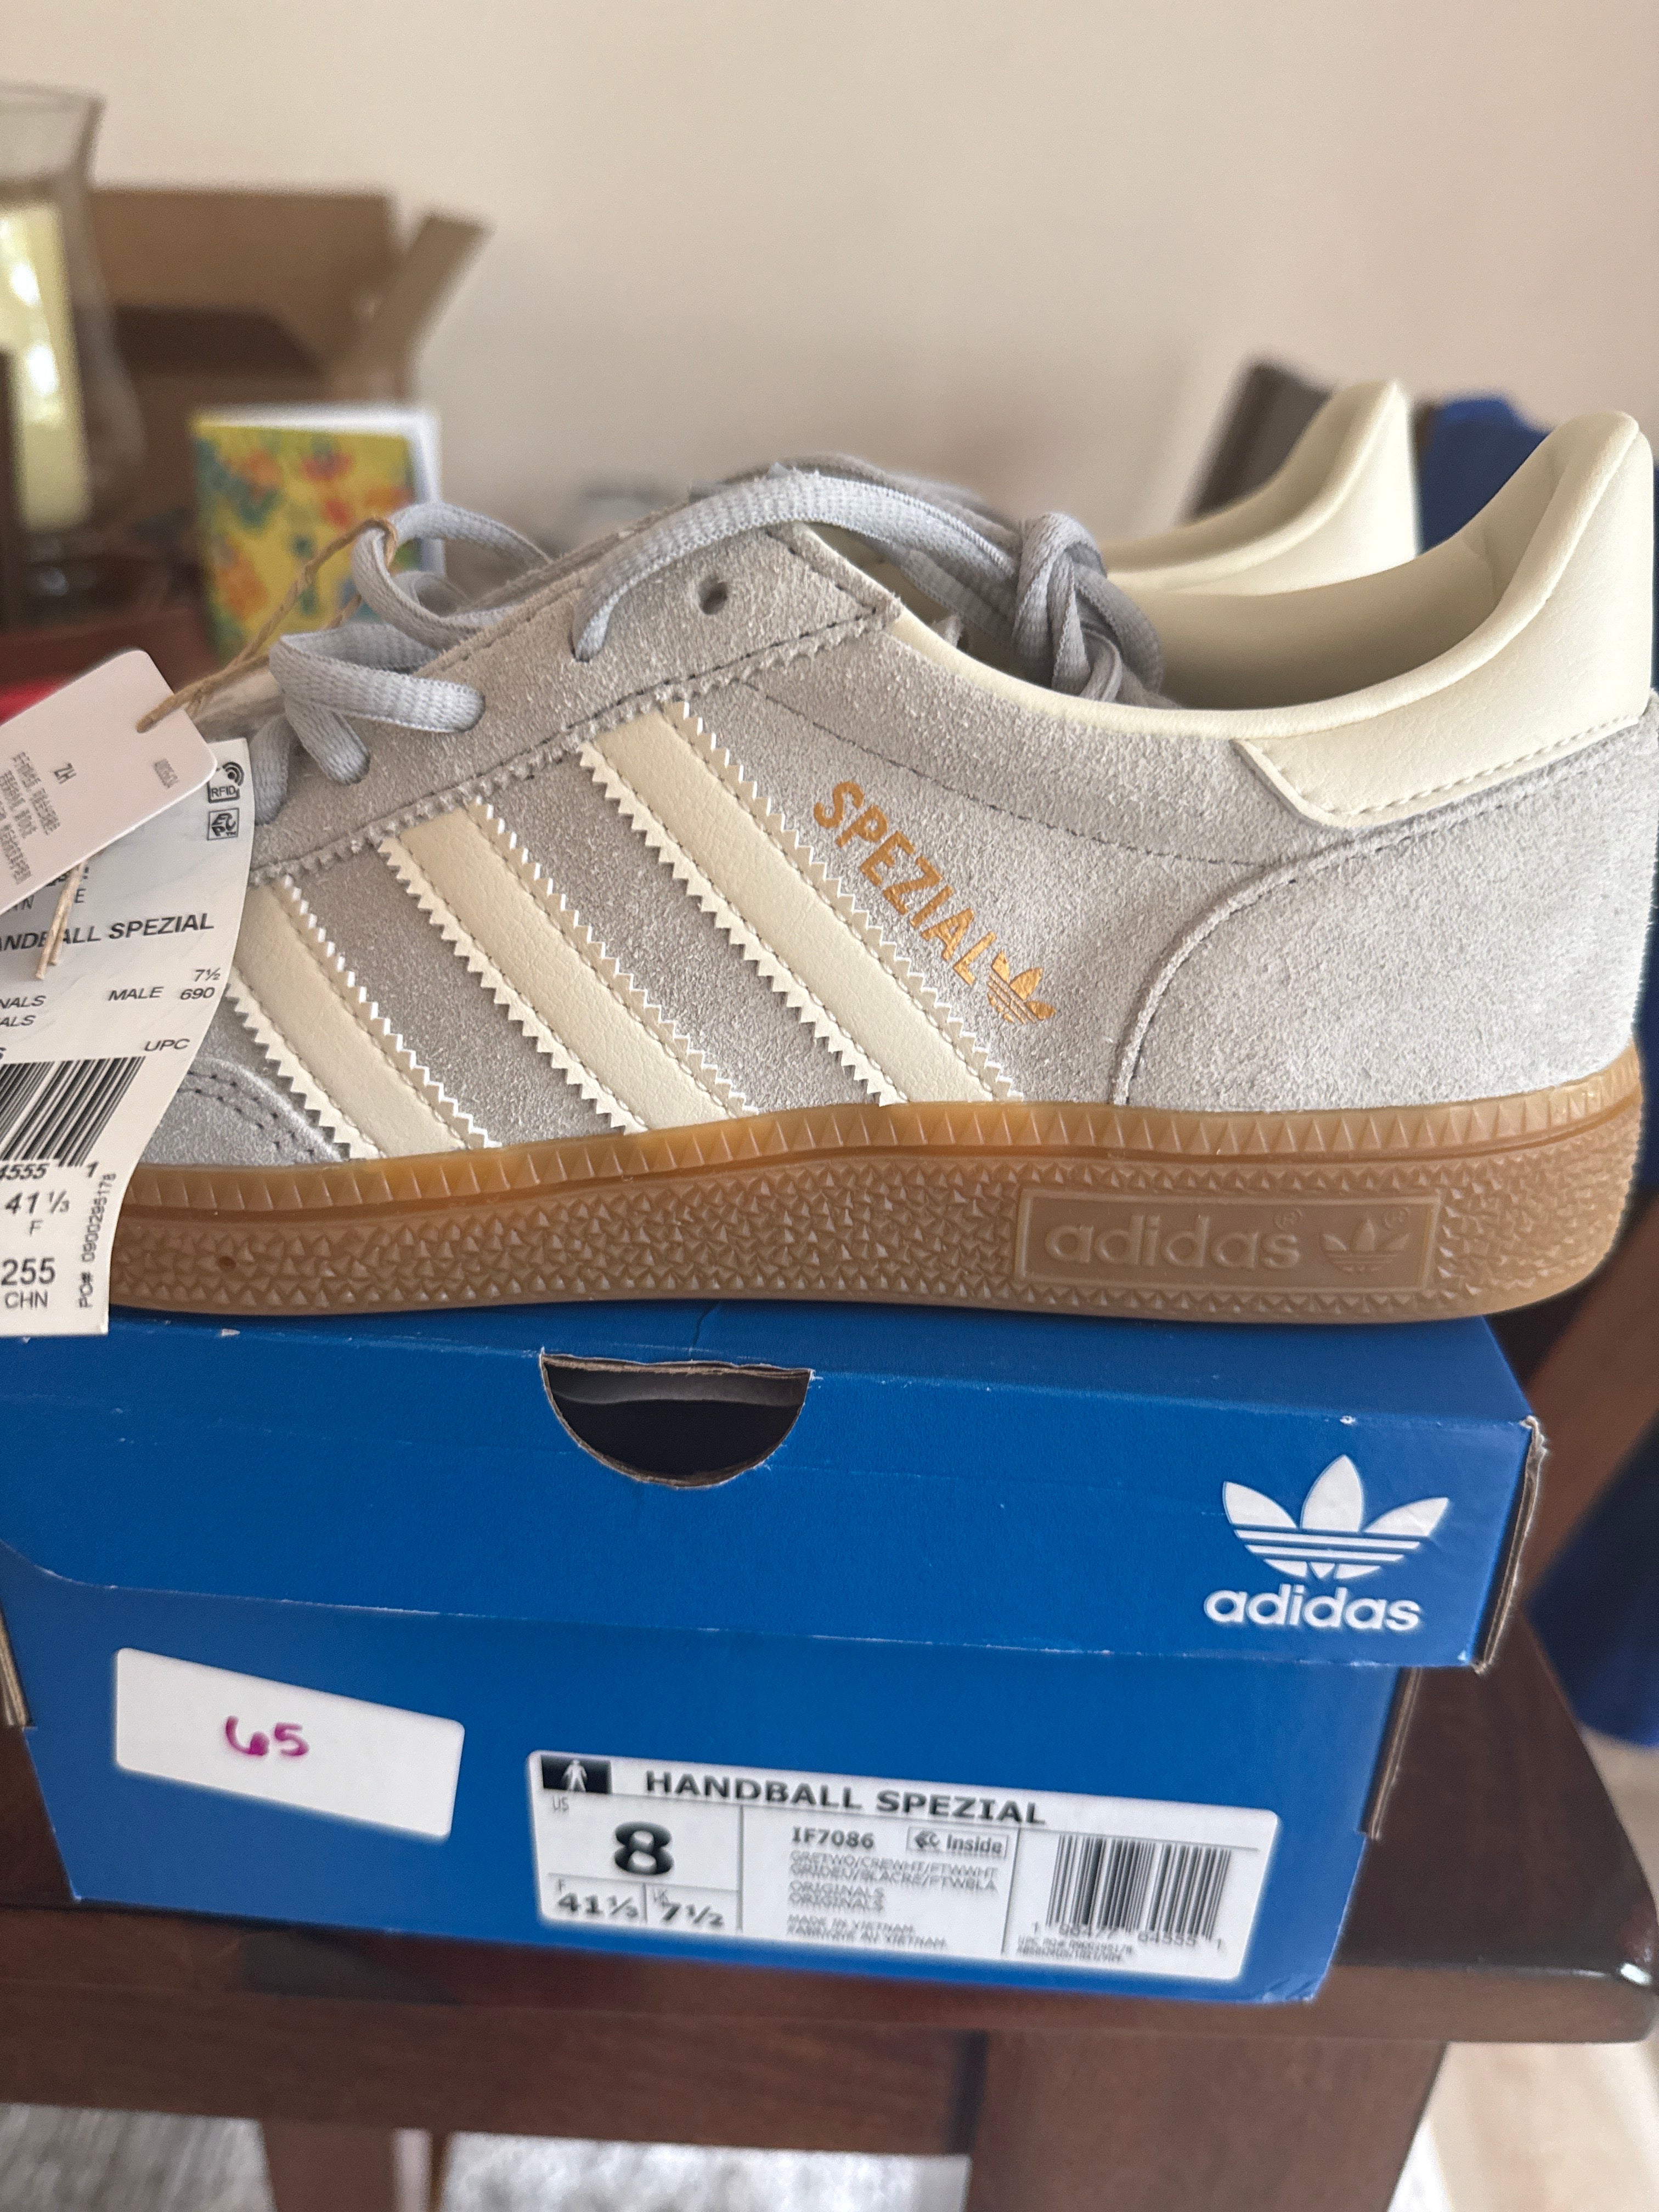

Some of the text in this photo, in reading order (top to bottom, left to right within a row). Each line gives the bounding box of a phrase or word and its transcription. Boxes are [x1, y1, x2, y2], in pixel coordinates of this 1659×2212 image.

[211, 785, 236, 797] RFID
[814, 781, 997, 985] SPEZIAL
[109, 913, 215, 940] SPEZIAL
[108, 986, 164, 1001] MALE
[180, 987, 215, 1001] 690
[144, 1039, 190, 1052] UPC
[86, 1161, 99, 1178] 1
[29, 1219, 44, 1237] F
[1045, 1214, 1300, 1269] adidas
[1, 1257, 55, 1285] 255
[5, 1289, 48, 1310] CHN
[1204, 1583, 1422, 1631] adidas
[225, 1715, 309, 1757] 65
[646, 1770, 1045, 1825] HANDBALL SPEZIAL
[614, 1821, 675, 1875] 8
[792, 1826, 876, 1850] IF7086
[946, 1833, 1003, 1854] Inside
